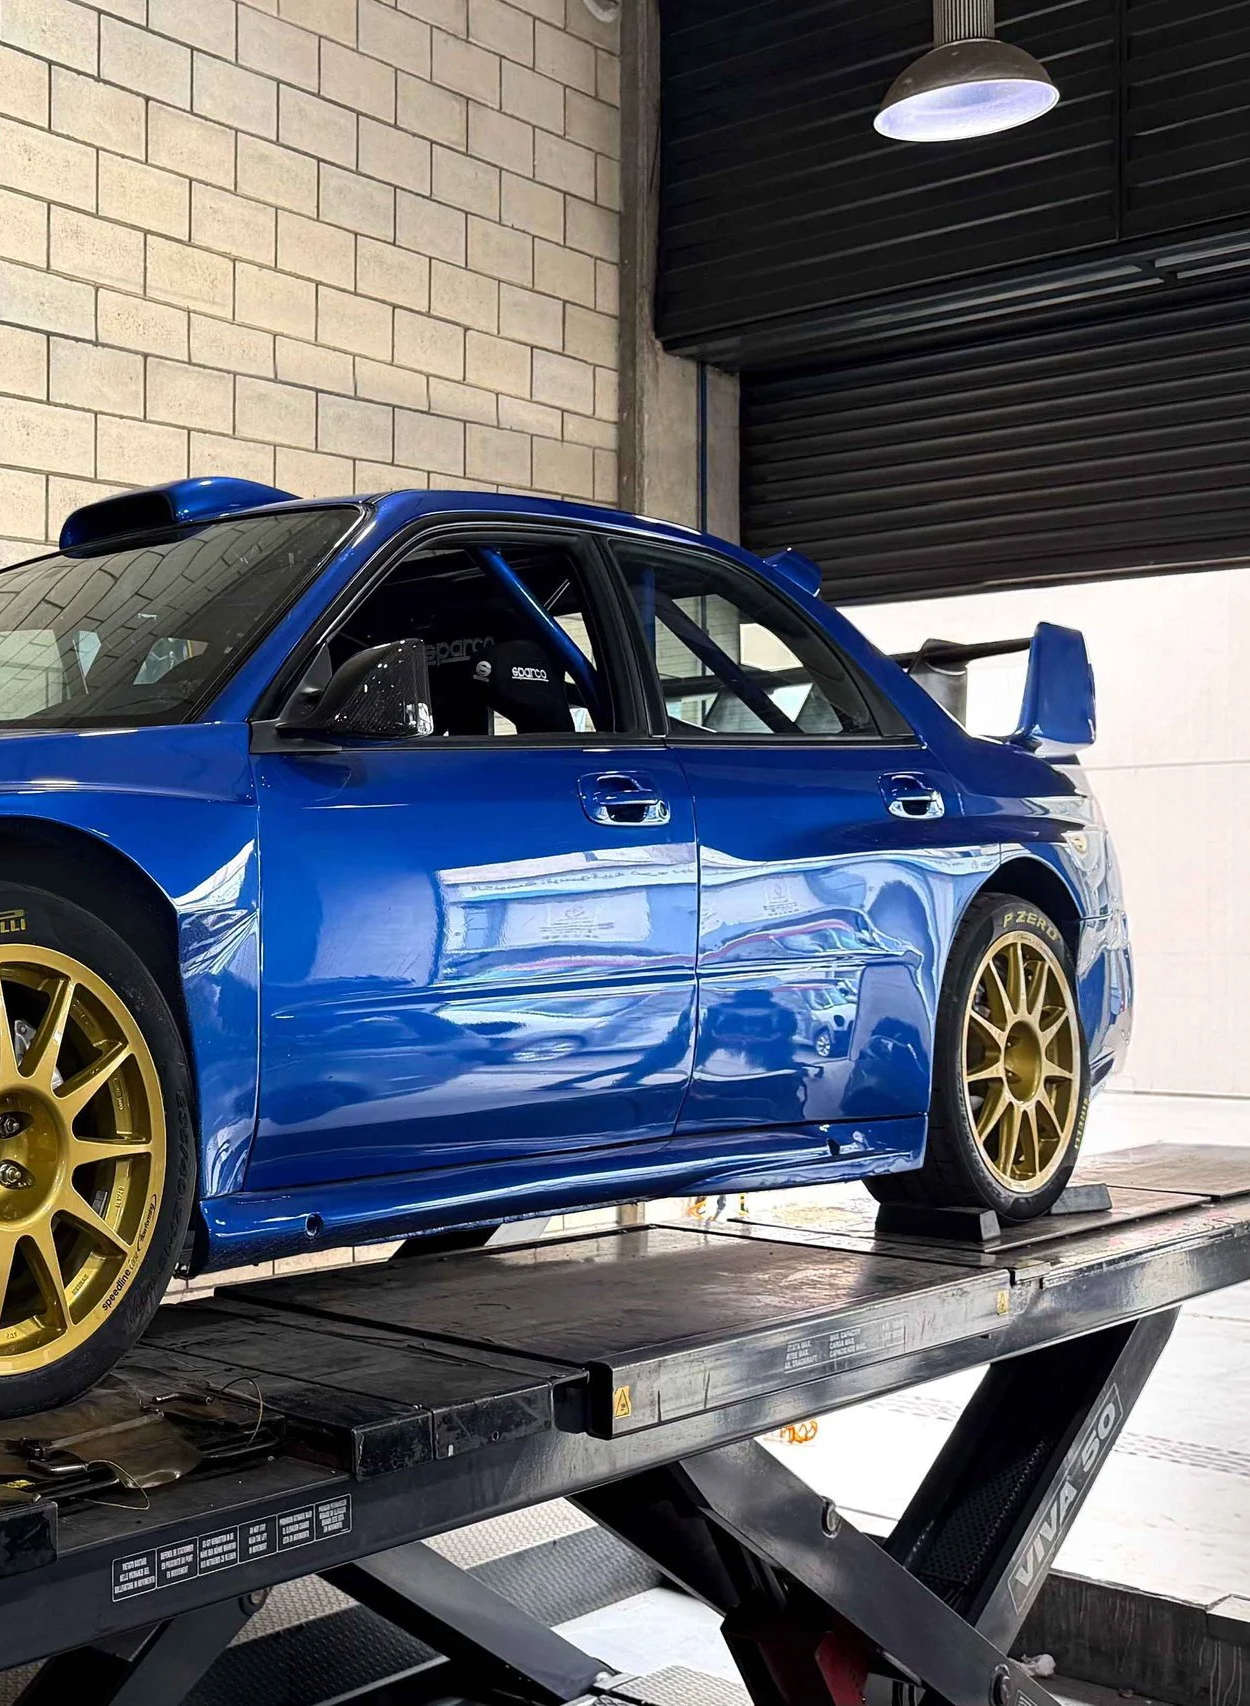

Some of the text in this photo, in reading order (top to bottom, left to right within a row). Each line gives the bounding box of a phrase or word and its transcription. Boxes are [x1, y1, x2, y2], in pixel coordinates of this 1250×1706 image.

[512, 666, 548, 681] sparco
[1003, 910, 1058, 941] P ZERO
[102, 1268, 131, 1311] speedline
[1015, 1403, 1116, 1587] VIVA 50
